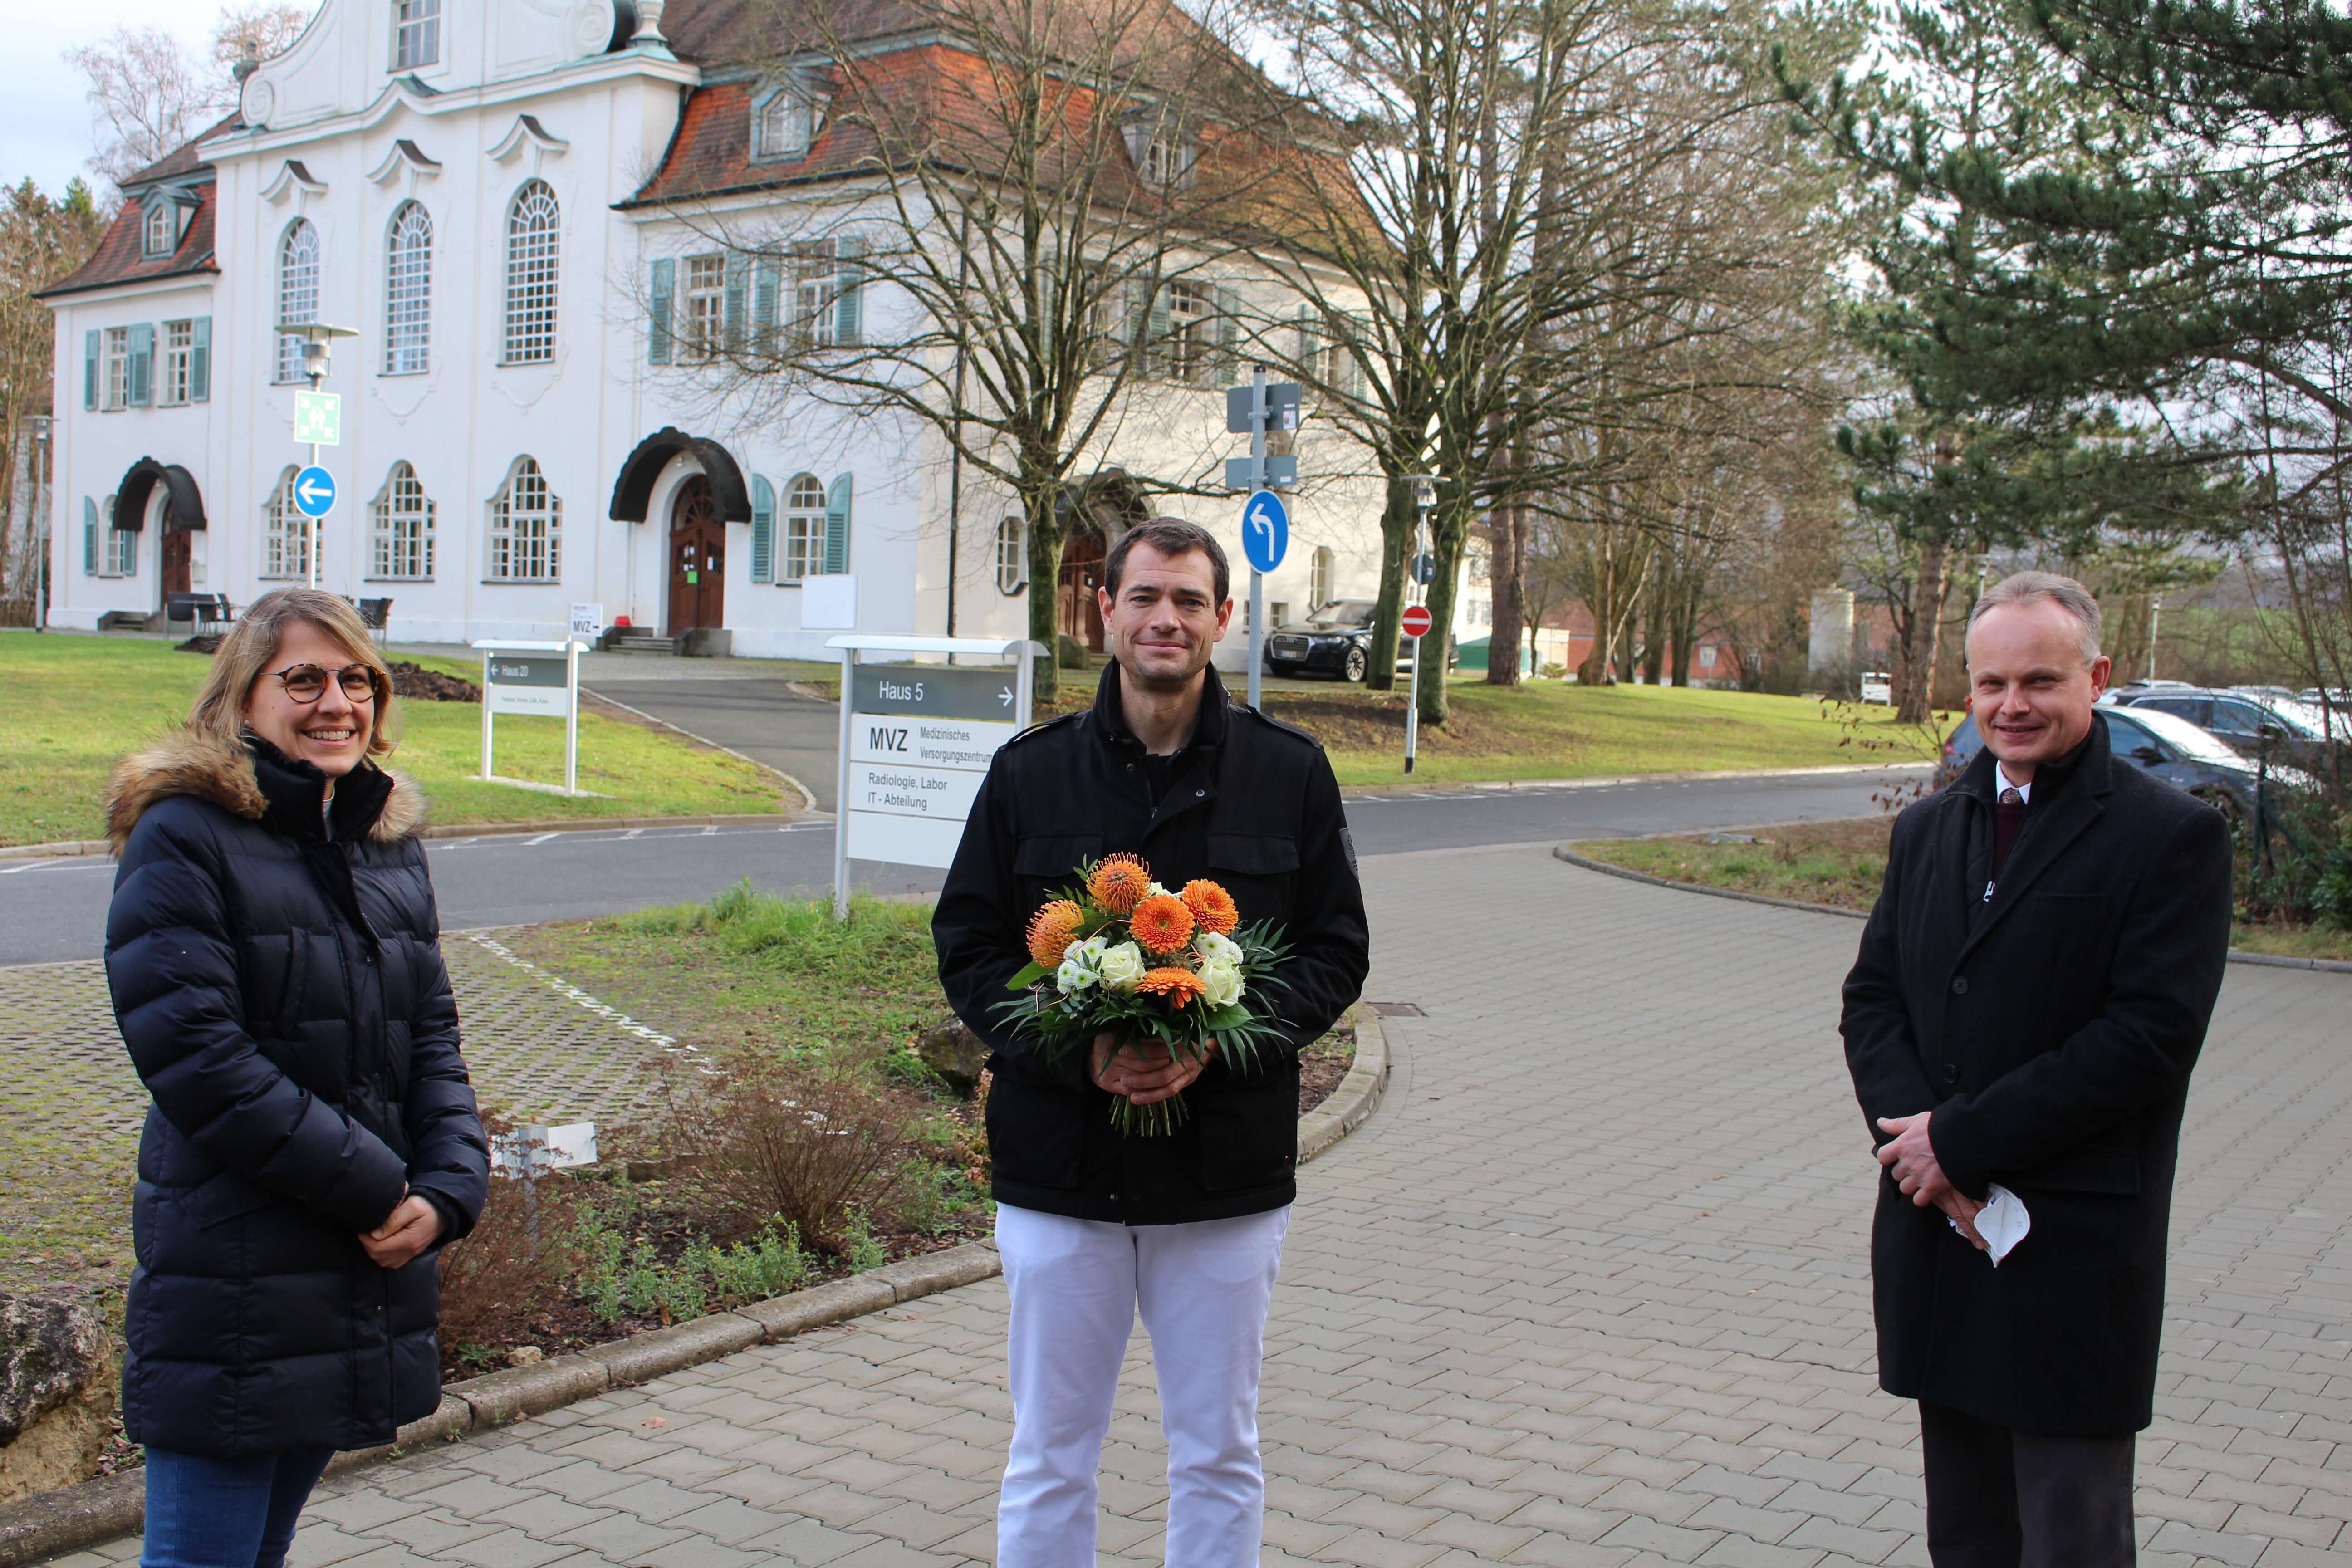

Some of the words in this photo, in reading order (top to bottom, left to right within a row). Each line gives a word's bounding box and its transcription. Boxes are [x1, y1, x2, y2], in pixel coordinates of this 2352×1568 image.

[573, 620, 591, 633] MVZ
[502, 665, 519, 676] Haus
[879, 681, 911, 700] Haus
[915, 682, 923, 701] 5
[870, 727, 907, 751] MVZ
[920, 726, 970, 741] Medizinisches
[920, 747, 992, 764] Versorgungszentrum
[869, 772, 918, 790] Radiologie,
[921, 777, 947, 790] Labor
[868, 792, 876, 803] IT
[884, 793, 927, 811] Abteilung
